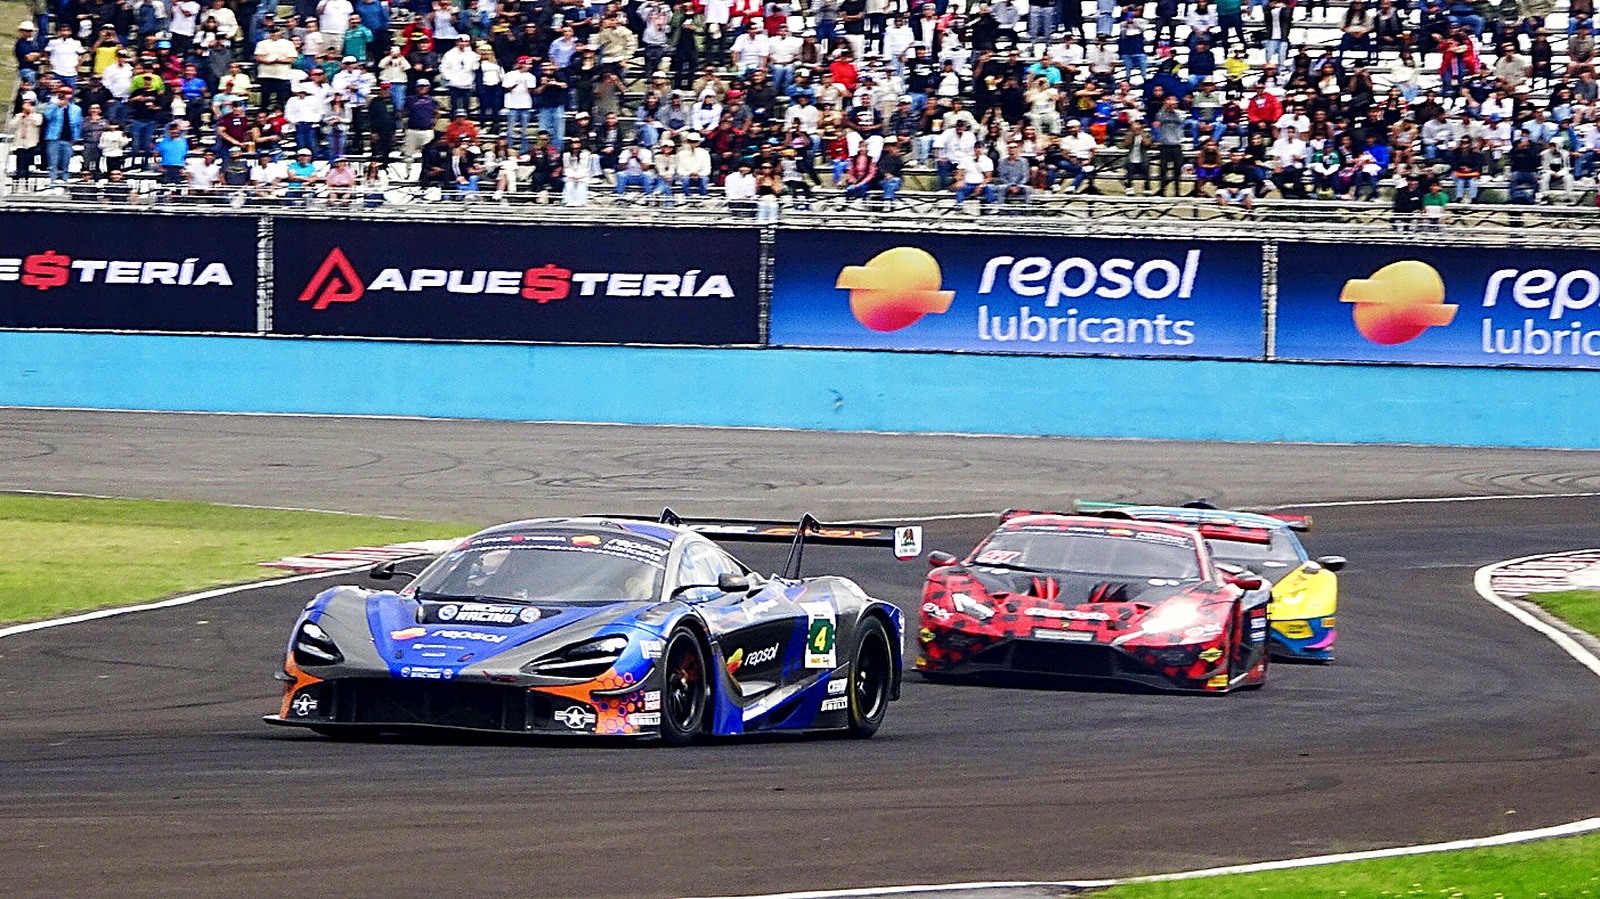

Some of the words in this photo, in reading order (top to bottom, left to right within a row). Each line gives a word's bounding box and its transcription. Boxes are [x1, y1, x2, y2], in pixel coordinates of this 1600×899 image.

[978, 249, 1200, 307] repsol
[1482, 269, 1600, 319] rep
[978, 305, 1195, 345] lubricants
[455, 611, 518, 623] RACING
[431, 629, 508, 643] repsol
[813, 626, 828, 651] 4
[744, 642, 780, 667] repsol
